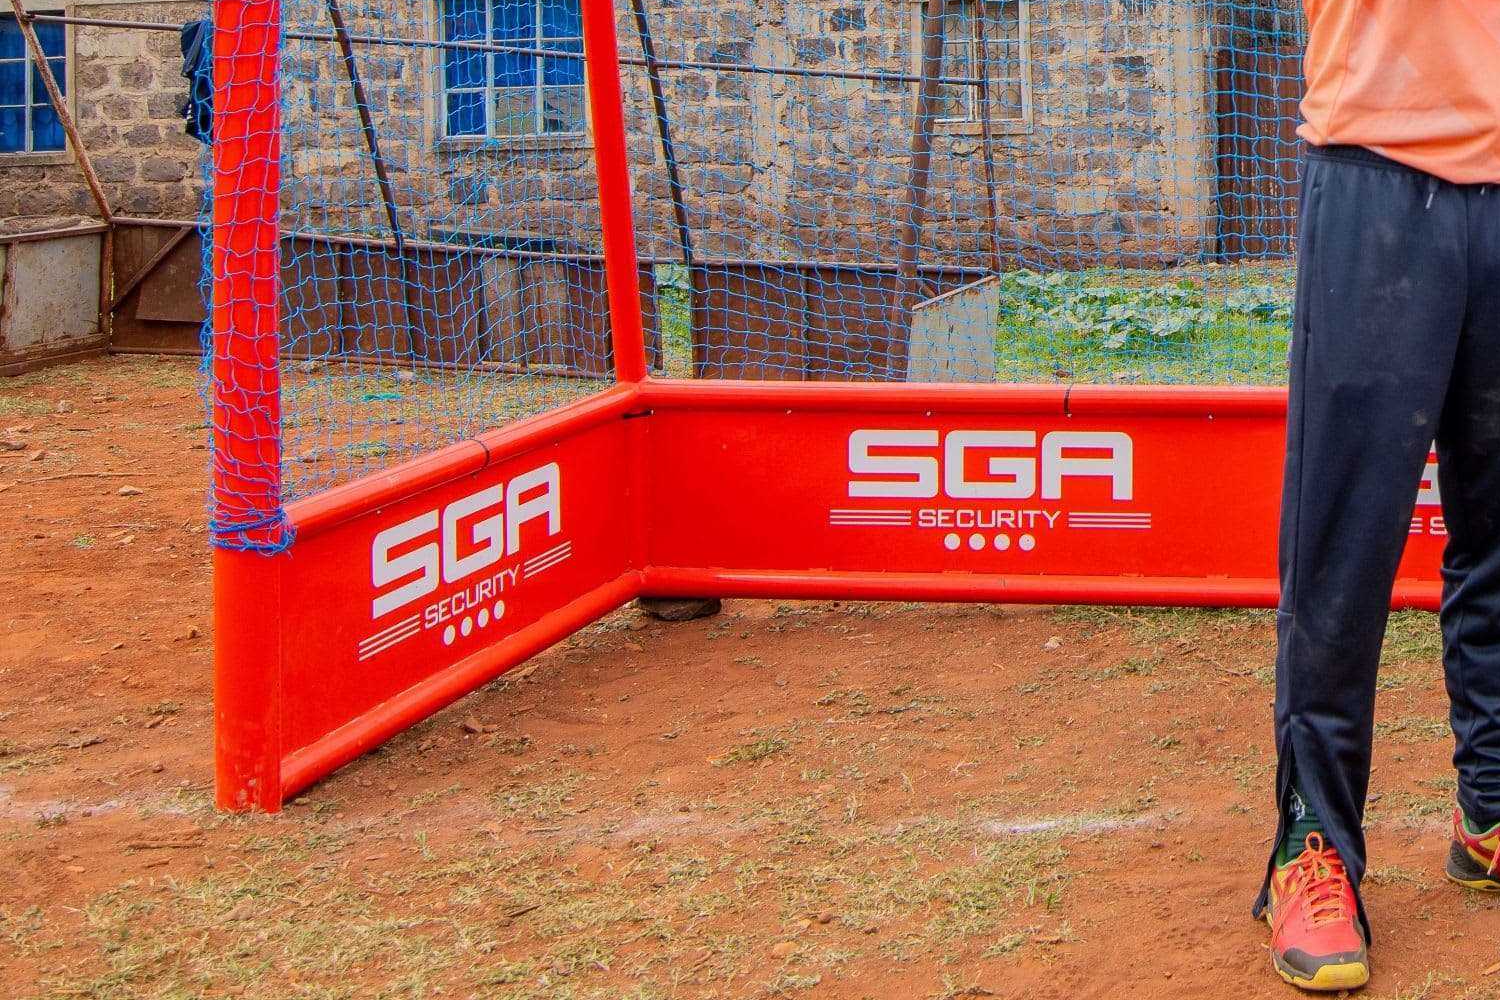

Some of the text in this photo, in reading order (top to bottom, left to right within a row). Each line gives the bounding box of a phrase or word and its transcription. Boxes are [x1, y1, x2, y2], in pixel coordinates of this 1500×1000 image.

[848, 429, 1133, 500] SGA
[372, 462, 561, 619] SGA
[918, 509, 1061, 529] SECURITY
[424, 564, 521, 629] SECURITY
